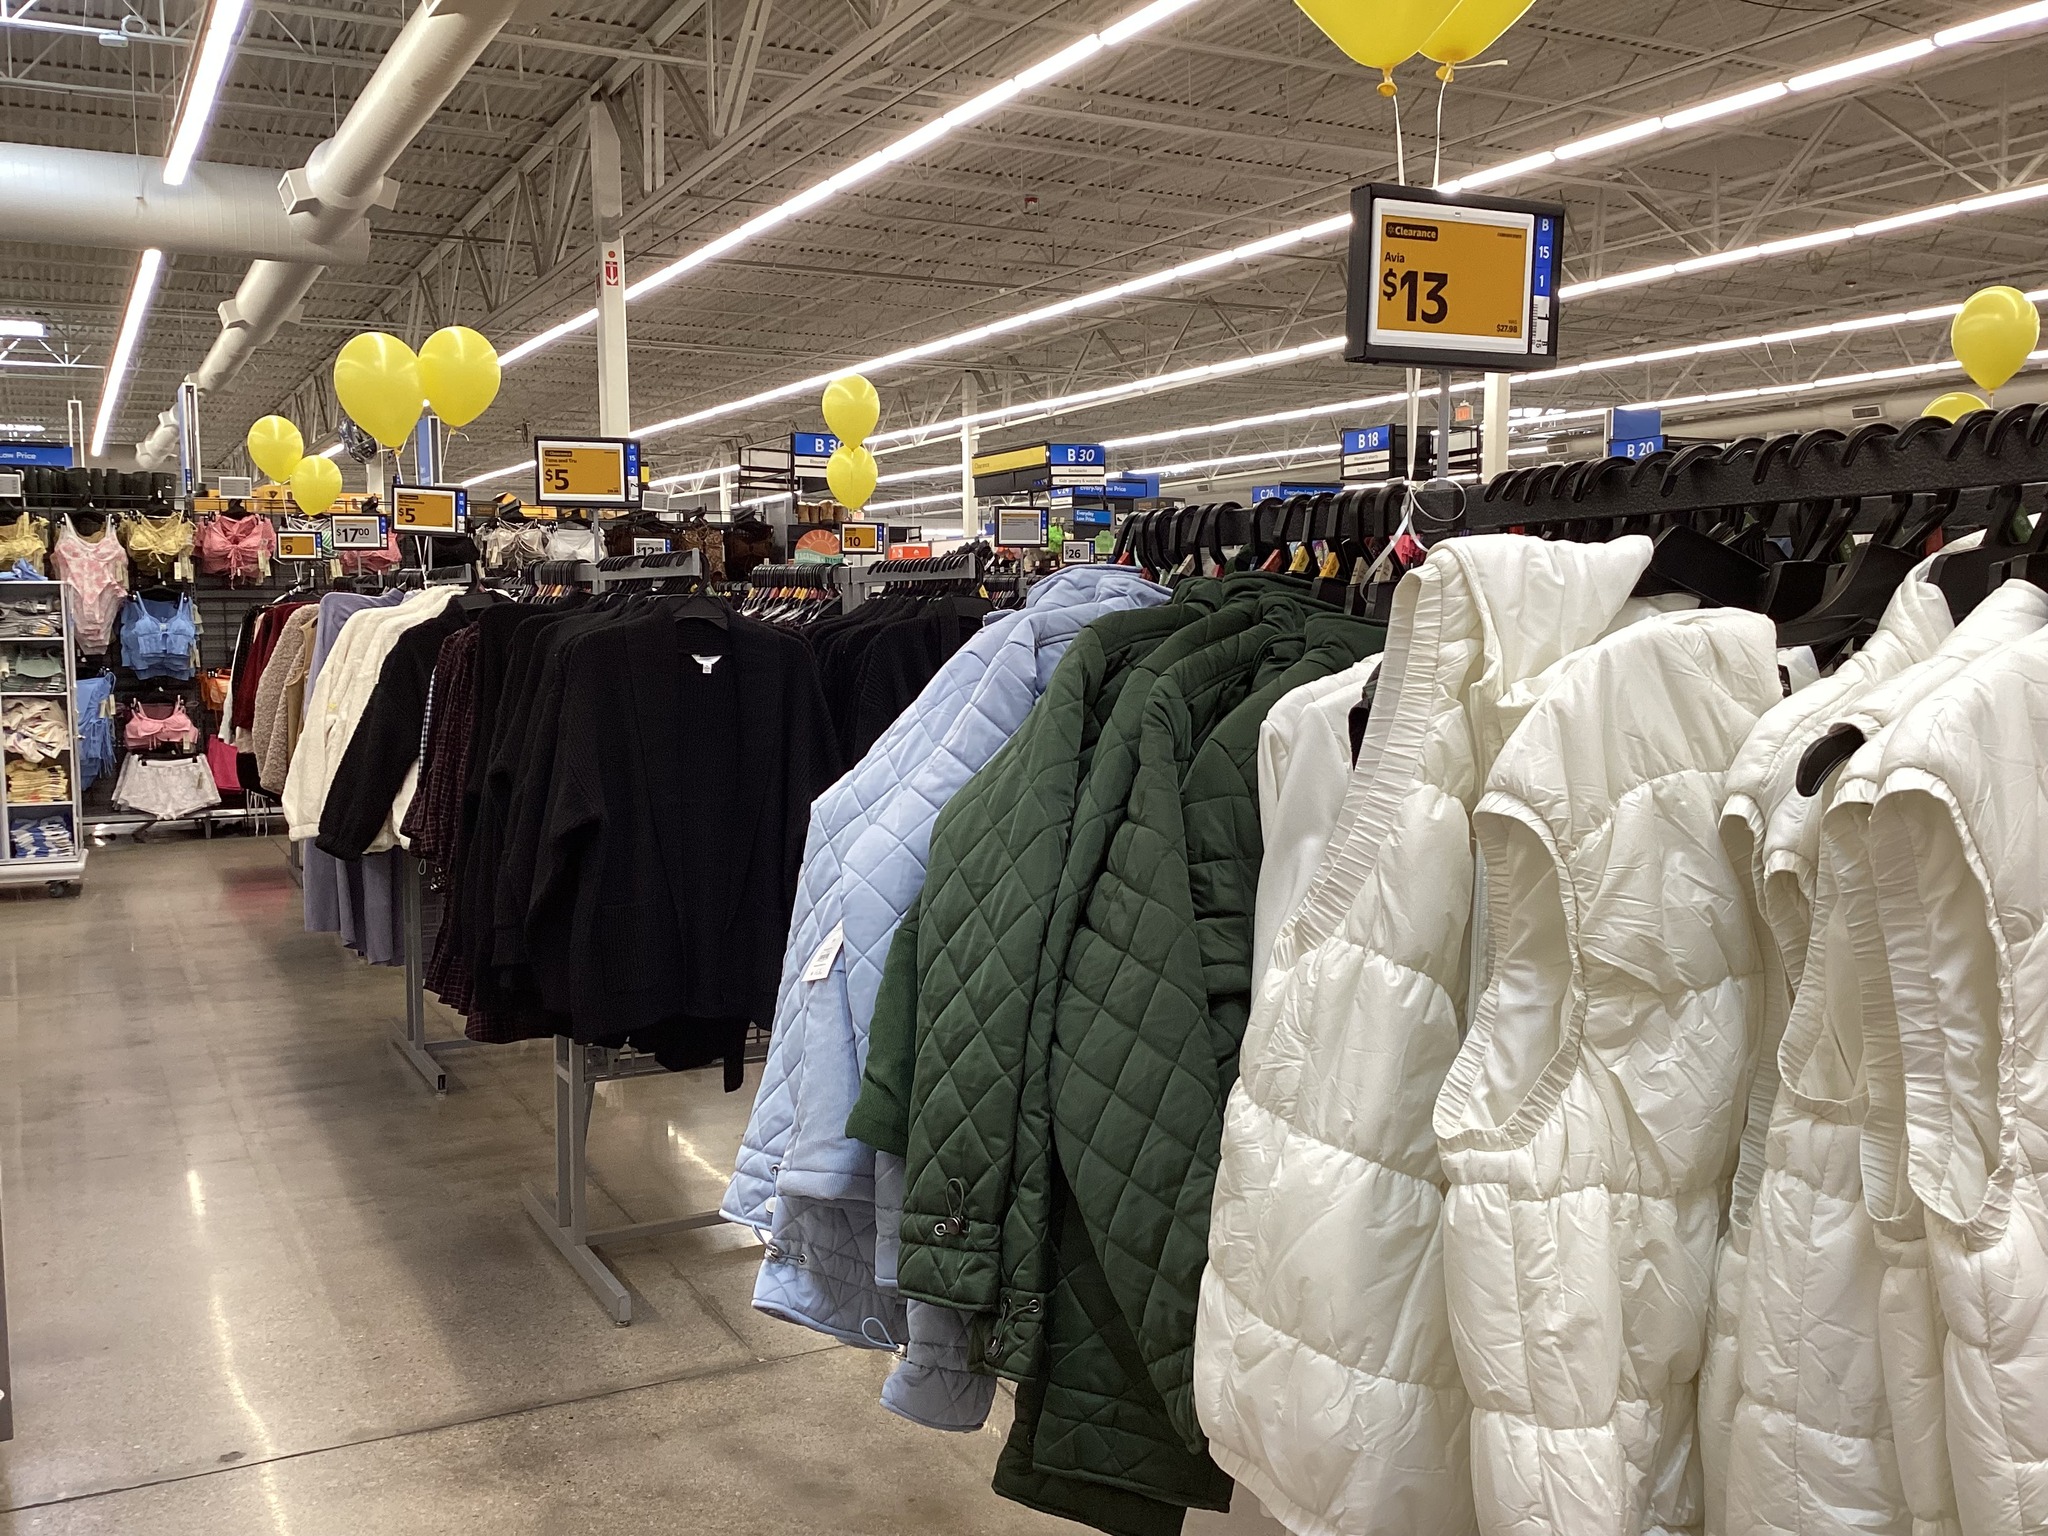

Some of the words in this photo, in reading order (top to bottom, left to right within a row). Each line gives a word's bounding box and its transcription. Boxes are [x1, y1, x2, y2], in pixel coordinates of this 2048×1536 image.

[1541, 218, 1550, 232] B
[1394, 225, 1437, 240] Clearance
[1384, 251, 1405, 263] Avia
[1539, 245, 1550, 259] 15
[1382, 267, 1449, 324] $13
[1496, 324, 1518, 333] $27.98
[815, 438, 825, 452] B
[1358, 433, 1366, 449] B
[1367, 431, 1379, 447] 18
[16, 451, 37, 460] Price
[1067, 448, 1076, 462] B
[1077, 448, 1095, 462] 30
[1627, 443, 1635, 457] B
[1638, 441, 1655, 456] 20
[545, 468, 569, 491] $5
[398, 507, 416, 523] $5
